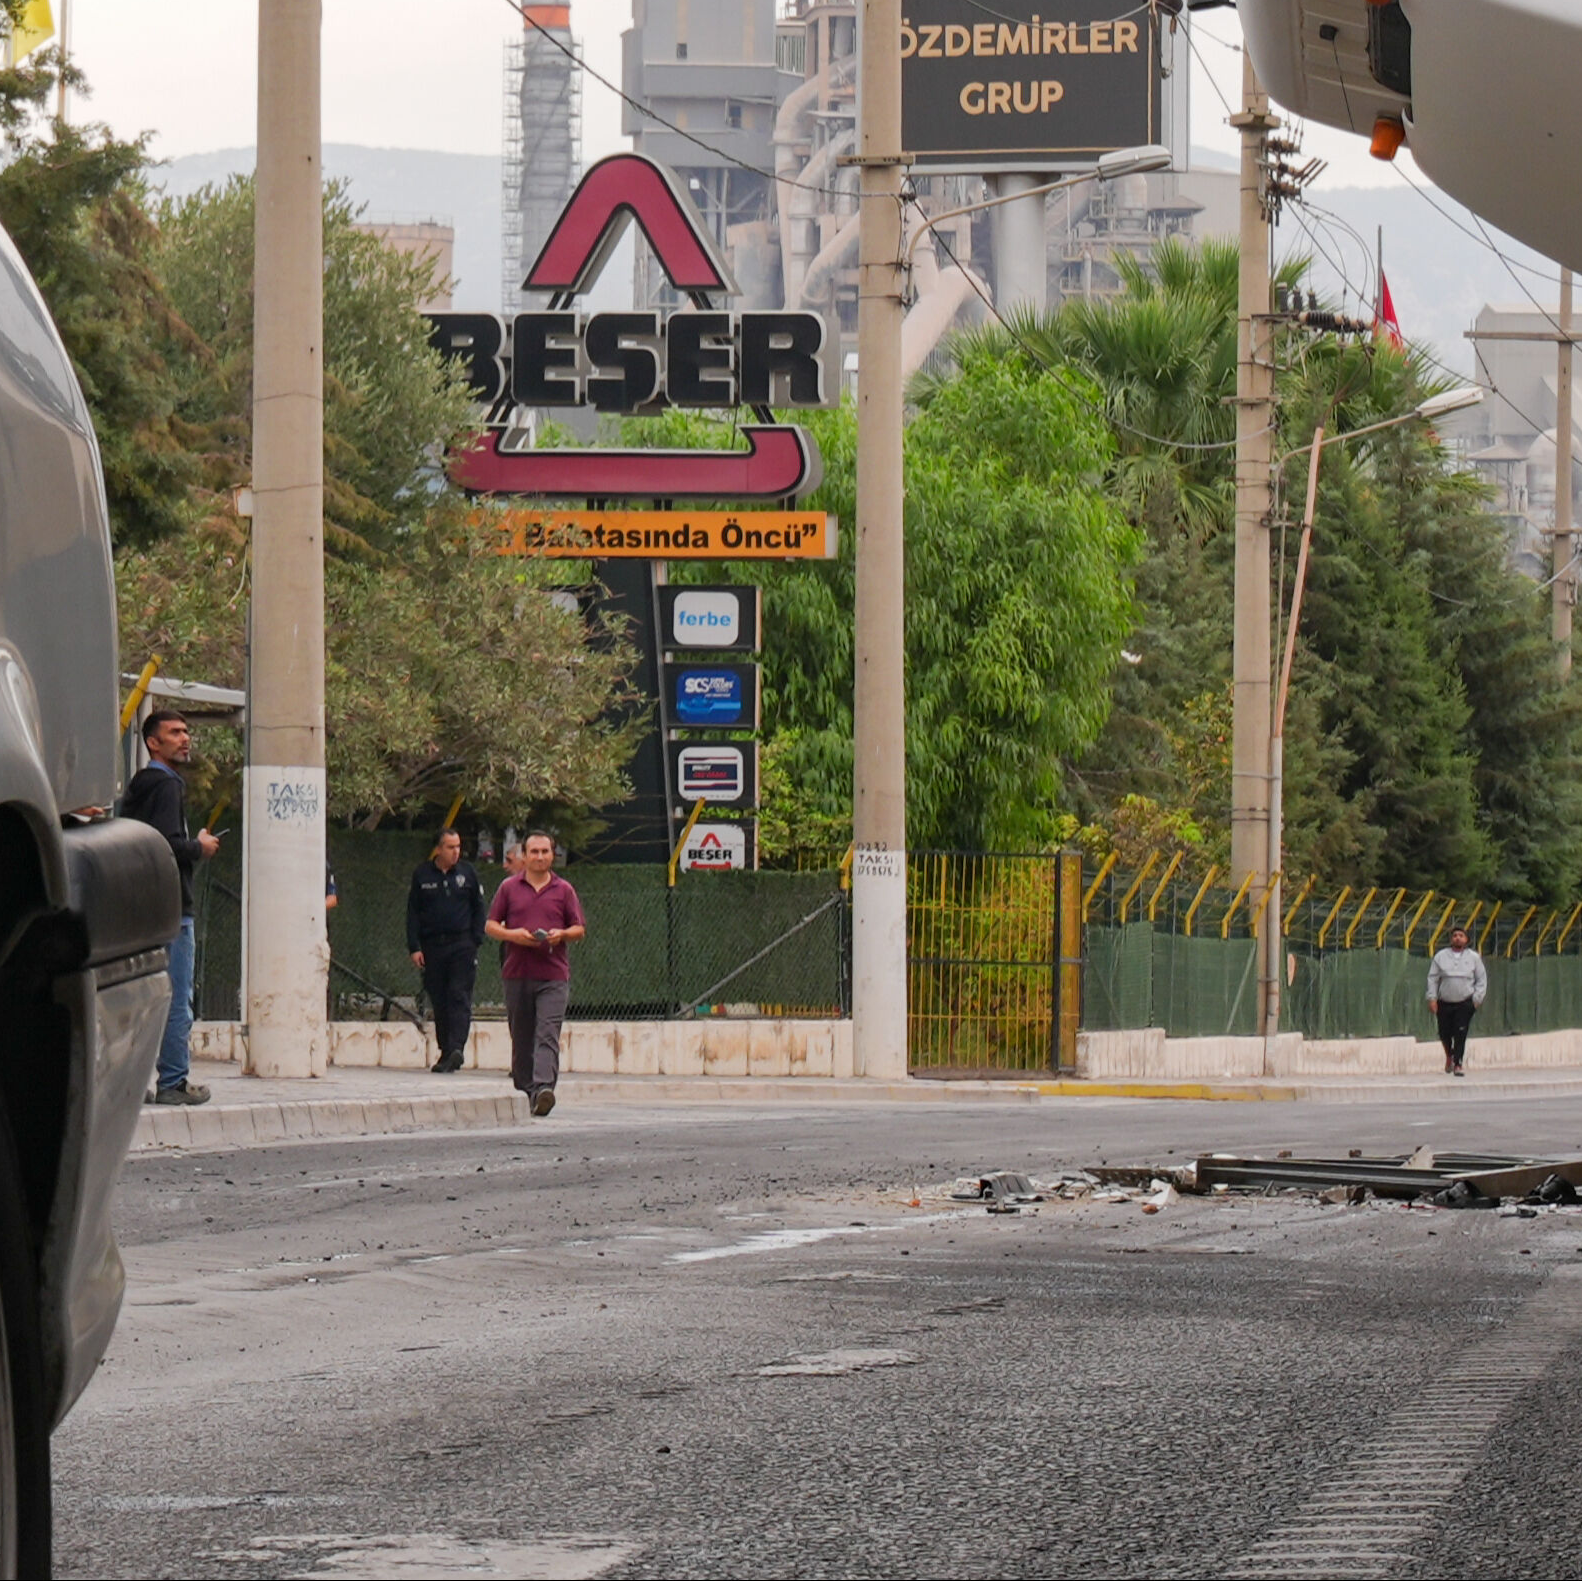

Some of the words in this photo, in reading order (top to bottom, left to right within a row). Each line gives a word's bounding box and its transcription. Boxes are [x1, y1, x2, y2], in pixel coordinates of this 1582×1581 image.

[901, 15, 1138, 58] ÖZDEMİRLER
[960, 80, 1064, 115] GRUP
[678, 611, 731, 627] ferbe
[685, 677, 710, 692] SCS
